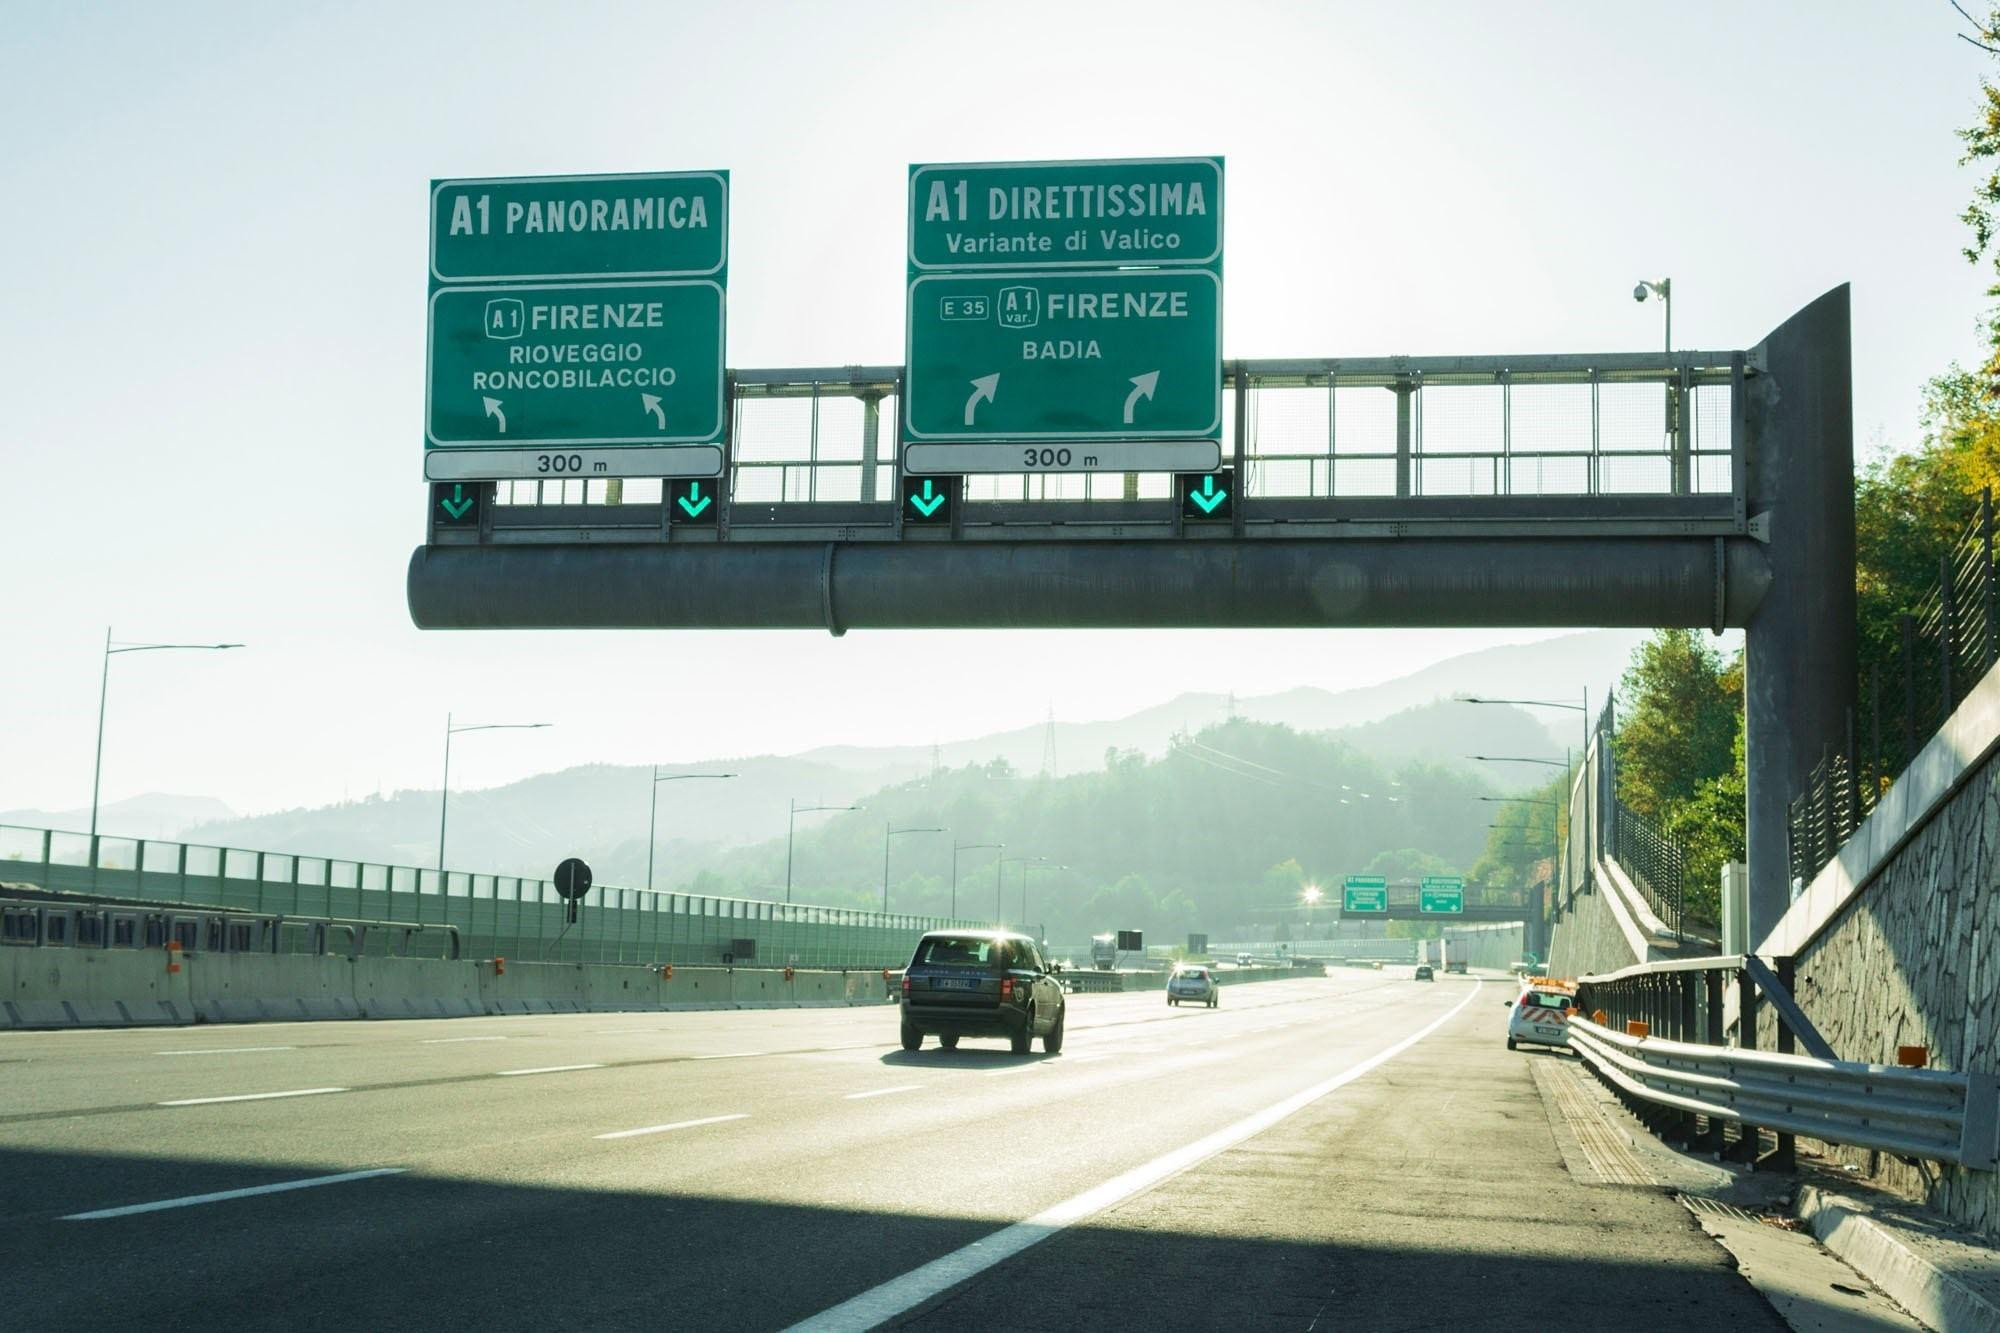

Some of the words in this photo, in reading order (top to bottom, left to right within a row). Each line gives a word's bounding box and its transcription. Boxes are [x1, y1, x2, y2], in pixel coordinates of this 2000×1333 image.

[926, 180, 967, 221] A1
[989, 182, 1206, 220] DIRETTISSIMA
[450, 195, 489, 235] A1
[507, 196, 707, 233] PANORAMICA
[946, 232, 1051, 253] Variante
[1065, 230, 1086, 251] di
[1100, 229, 1180, 249] Valico
[532, 303, 663, 330] FIRENZE
[1048, 292, 1188, 319] FIRENZE
[1007, 314, 1031, 323] var.
[509, 343, 642, 364] RIOVEGGIO
[1023, 340, 1101, 359] BADIA
[473, 368, 676, 390] RONCOBILACCIO
[537, 454, 582, 472] 300
[593, 462, 607, 472] m
[1024, 448, 1071, 467] 300
[1084, 456, 1097, 466] m
